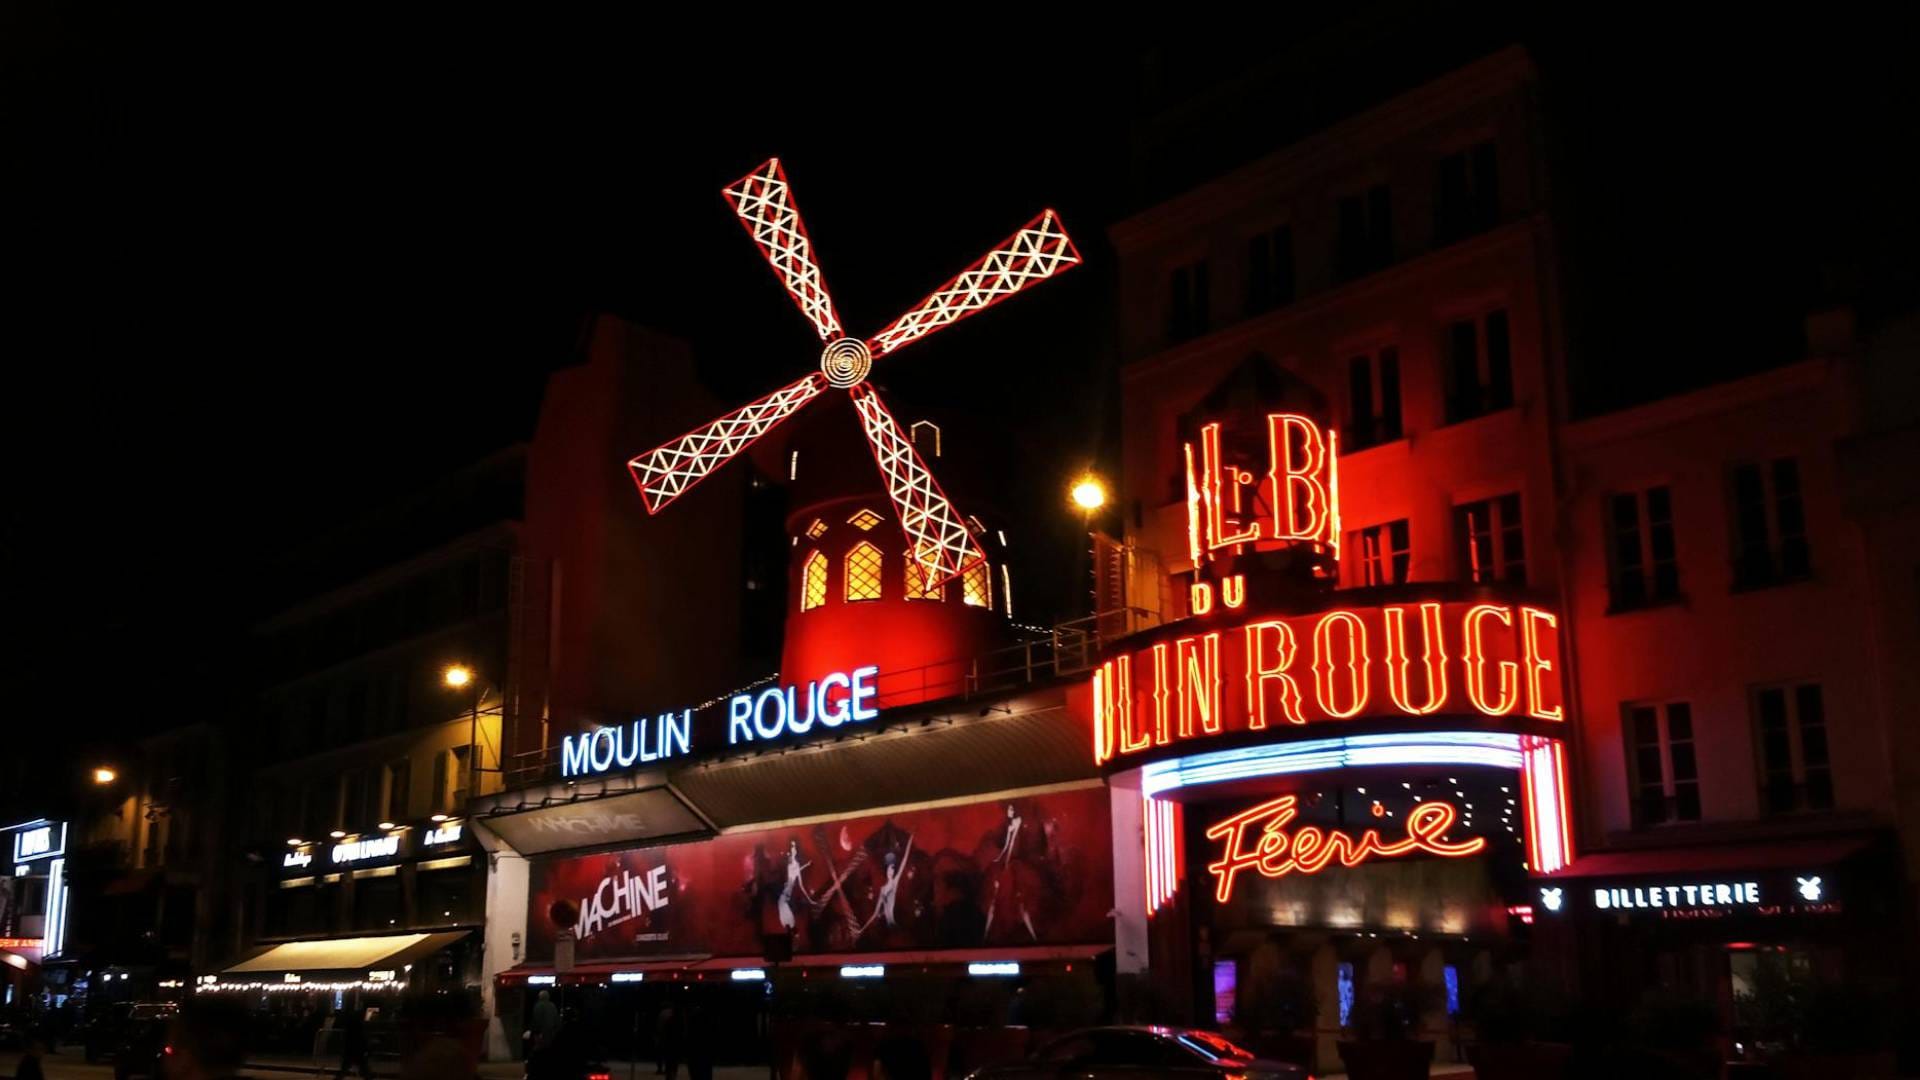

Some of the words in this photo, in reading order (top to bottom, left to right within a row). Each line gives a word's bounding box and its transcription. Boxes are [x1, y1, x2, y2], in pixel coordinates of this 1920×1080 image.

[1191, 575, 1244, 615] DU
[1245, 603, 1563, 730] ROUGE
[562, 709, 690, 776] MOULIN
[729, 666, 879, 744] ROUGE
[1206, 795, 1486, 902] Féerie
[573, 865, 669, 940] MACHINE
[1595, 882, 1760, 909] BILLETTERIE
